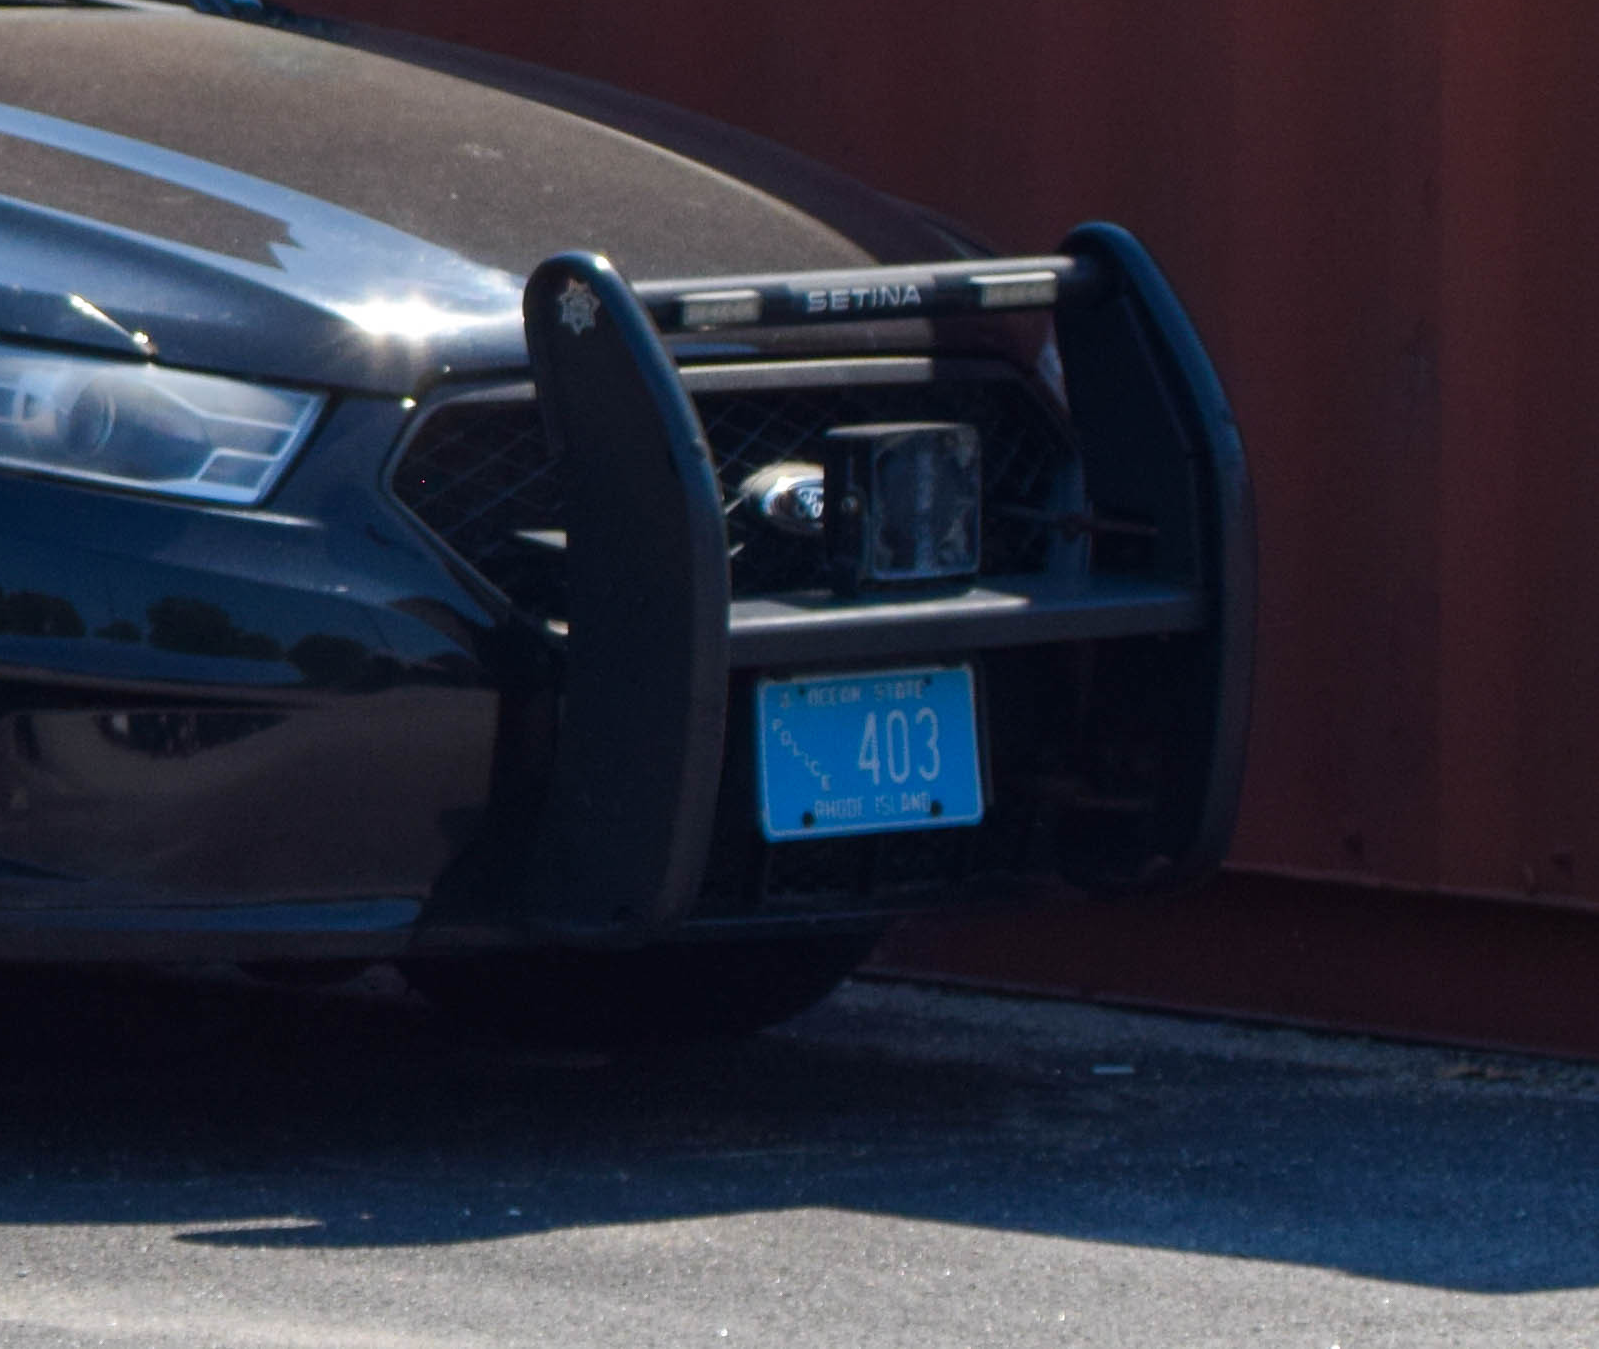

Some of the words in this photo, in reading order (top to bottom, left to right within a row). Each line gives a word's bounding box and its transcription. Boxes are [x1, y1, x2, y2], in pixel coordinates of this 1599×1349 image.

[807, 284, 922, 313] SETINA
[772, 718, 832, 791] POLICE
[858, 706, 941, 786] 403
[815, 796, 864, 819] RHODE
